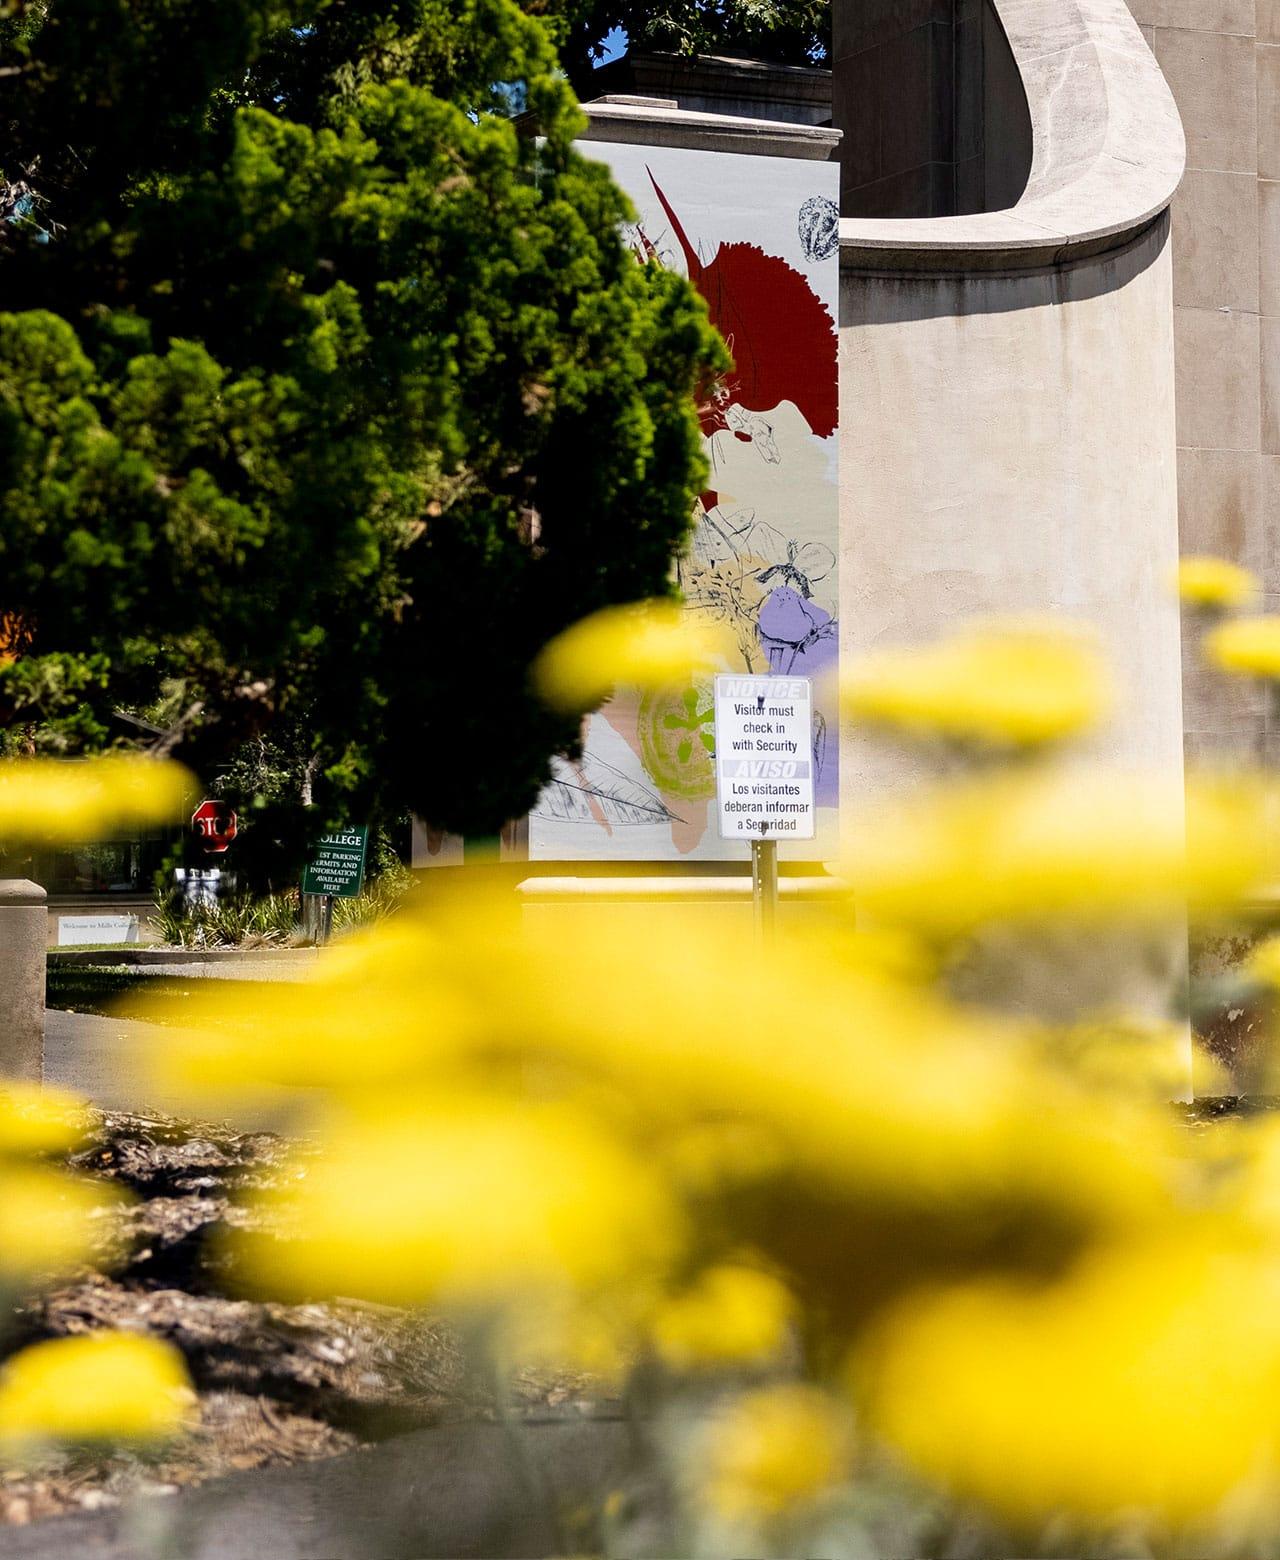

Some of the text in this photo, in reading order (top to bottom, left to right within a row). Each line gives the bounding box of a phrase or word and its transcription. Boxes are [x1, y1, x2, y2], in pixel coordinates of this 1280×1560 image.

[726, 680, 801, 698] NOTICE
[734, 703, 794, 717] Visitor must
[743, 721, 785, 734] check in
[732, 739, 798, 754] with Security
[735, 760, 797, 778] AVISO
[732, 783, 800, 796] Los visitantes
[724, 800, 810, 813] deberan informar
[737, 820, 744, 830] a
[318, 834, 362, 846] OLLEGE
[332, 852, 362, 861] PARKING
[310, 866, 358, 877] INFORMATION
[315, 876, 350, 884] AVAILABLE
[323, 883, 341, 891] HERE
